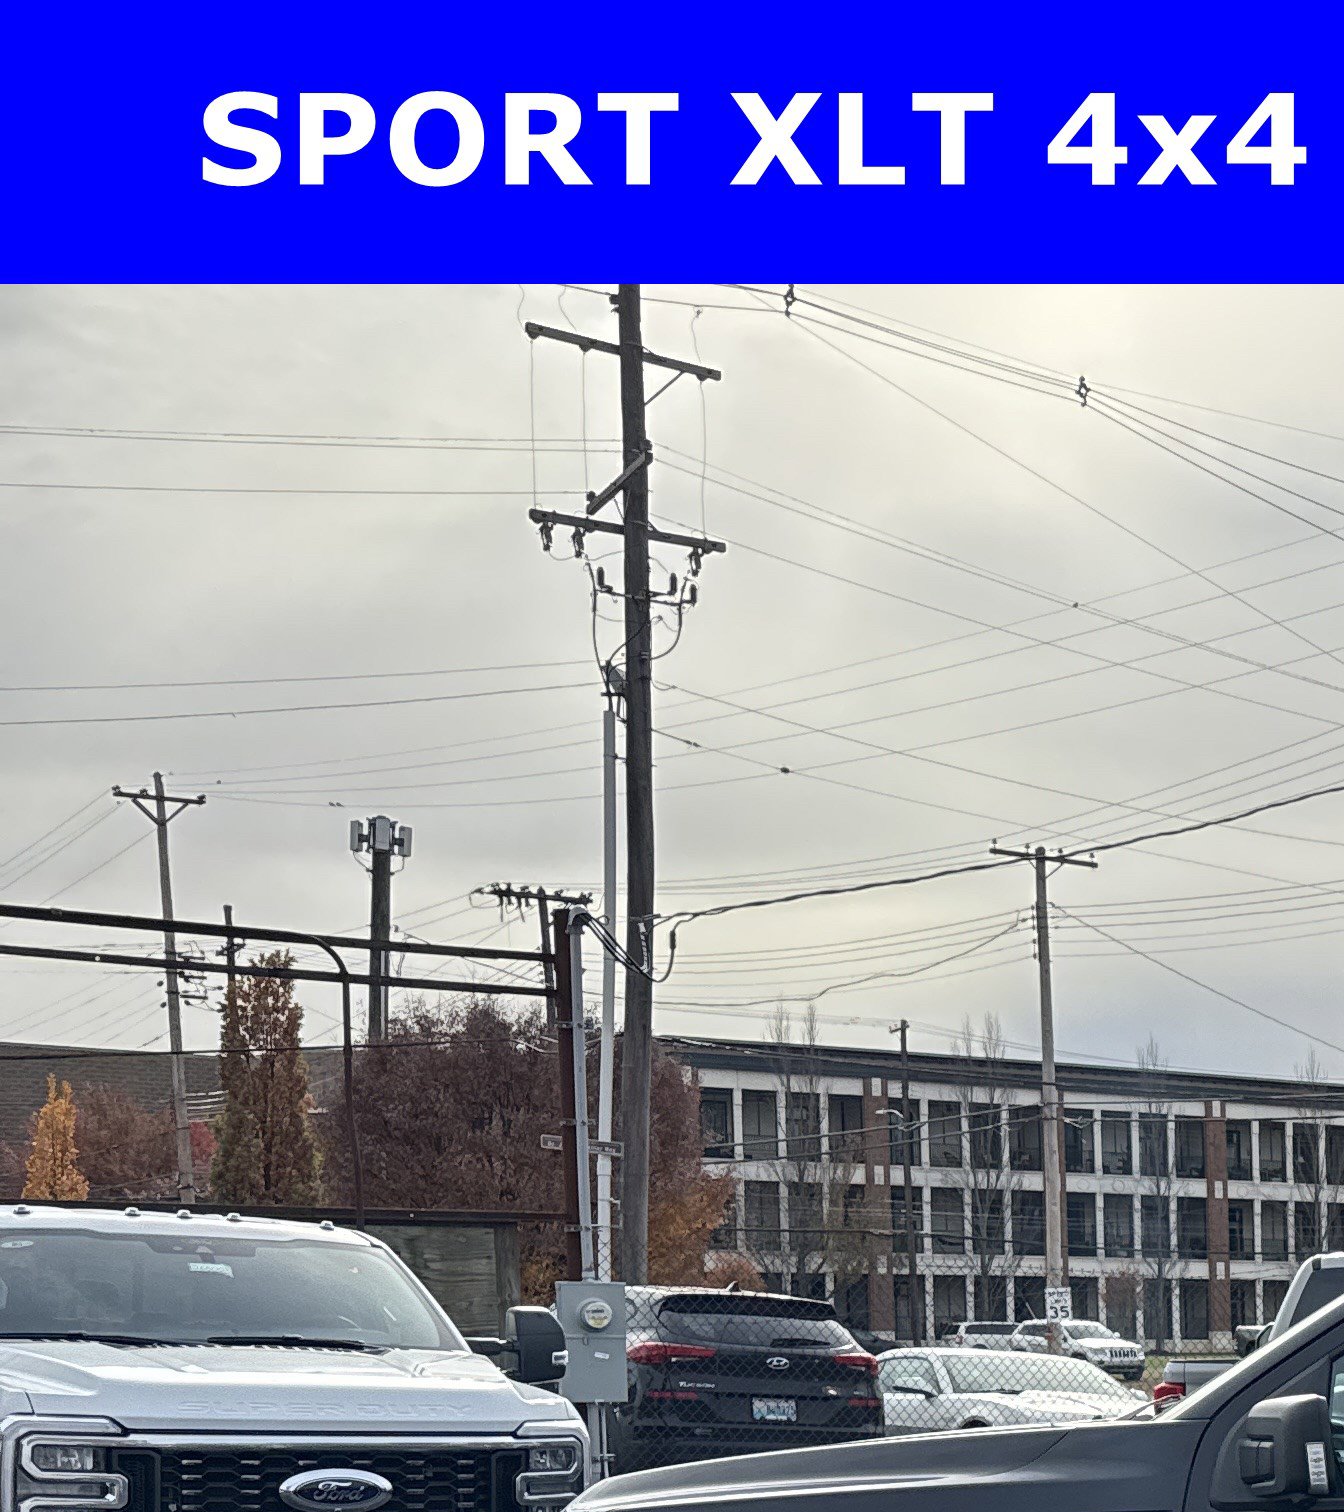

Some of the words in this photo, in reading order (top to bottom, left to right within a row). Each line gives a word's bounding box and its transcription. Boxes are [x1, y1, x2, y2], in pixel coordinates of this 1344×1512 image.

[1049, 1305, 1069, 1319] 35
[177, 1400, 346, 1417] SUPER
[355, 1402, 472, 1417] DUTY
[313, 1481, 365, 1501] Ford
